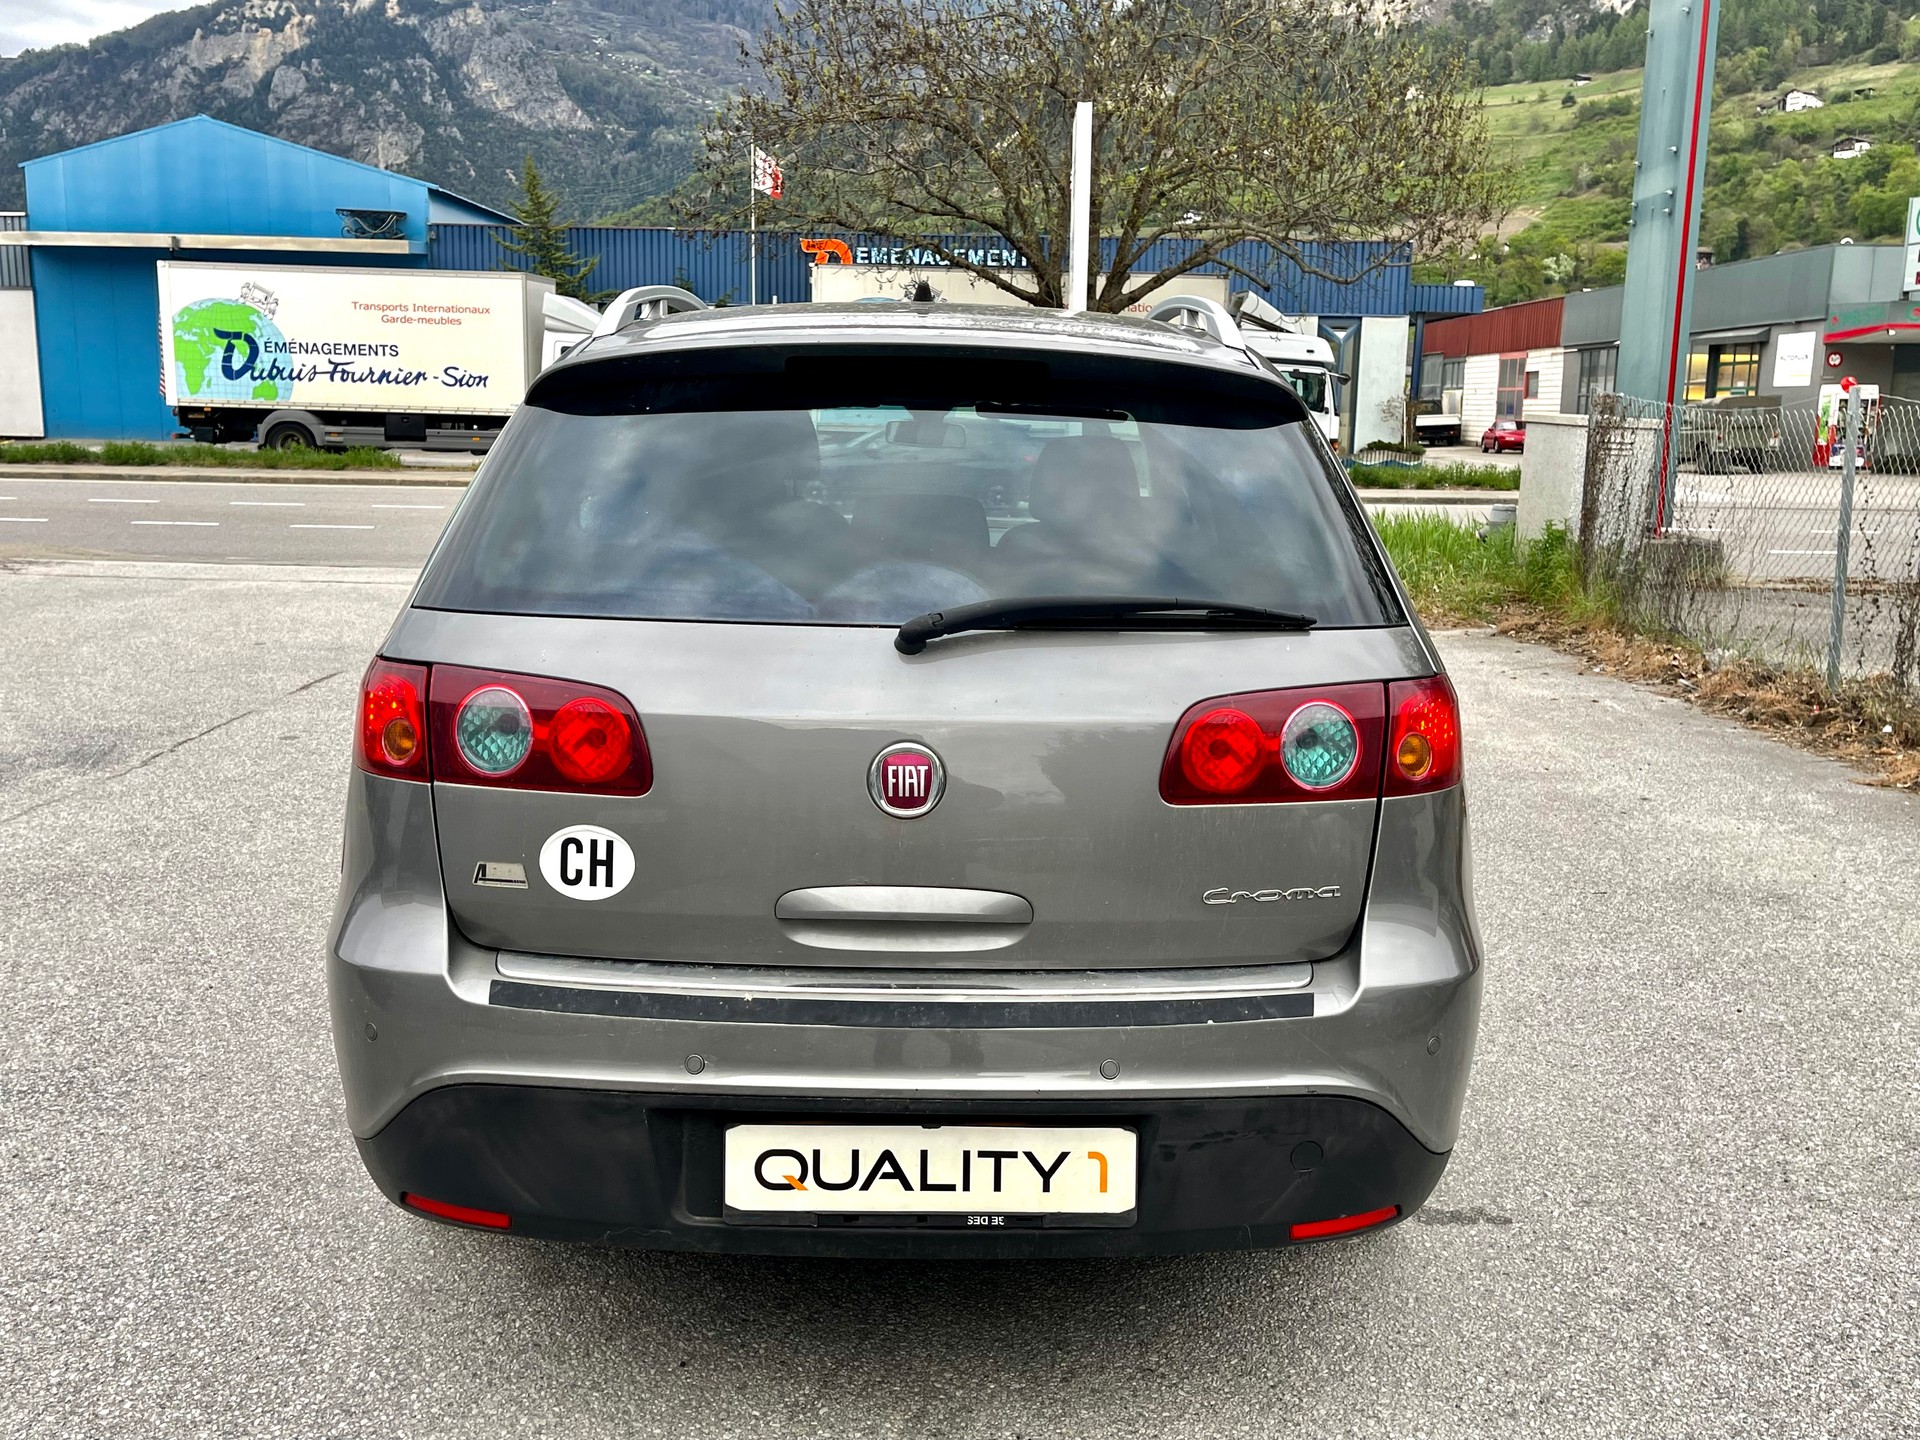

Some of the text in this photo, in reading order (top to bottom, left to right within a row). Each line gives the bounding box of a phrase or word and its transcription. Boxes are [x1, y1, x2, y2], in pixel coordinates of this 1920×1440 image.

[351, 301, 491, 315] Transports Internationaux
[381, 314, 463, 326] Garde-meubles
[887, 765, 929, 798] FIAT
[560, 837, 614, 888] CH
[1202, 885, 1342, 905] Croma
[754, 1148, 1108, 1193] QUALITY 1
